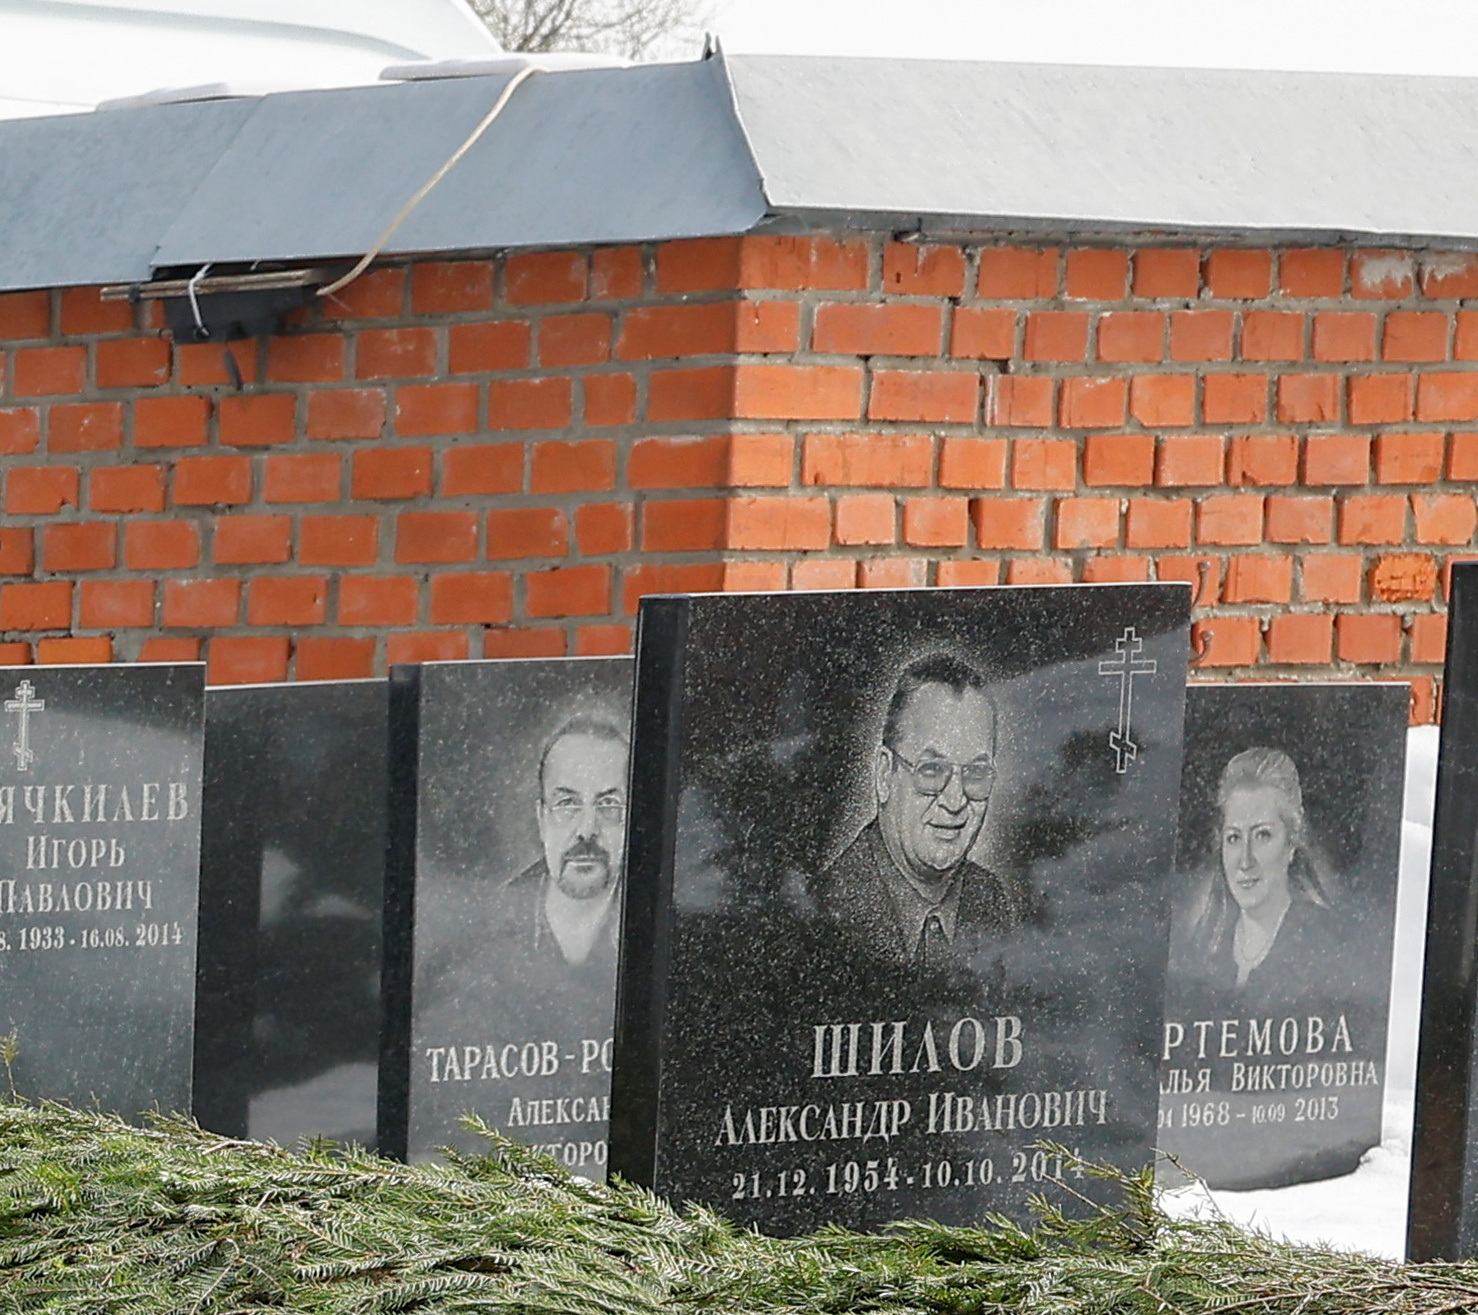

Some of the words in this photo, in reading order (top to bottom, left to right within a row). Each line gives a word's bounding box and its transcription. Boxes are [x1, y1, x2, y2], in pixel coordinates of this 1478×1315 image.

[26, 835, 125, 870] ИГОРЬ
[811, 1016, 1023, 1078] ШИЛОВ
[1162, 1014, 1353, 1061] РТЕМОВА
[1231, 1061, 1379, 1092] ВИКТОРОВНА
[714, 1100, 911, 1148] АЛЕКСАНДР
[926, 1089, 1109, 1134] ИВАНОВИЧ
[1181, 1102, 1230, 1127] 1968
[1295, 1096, 1339, 1121] 2013
